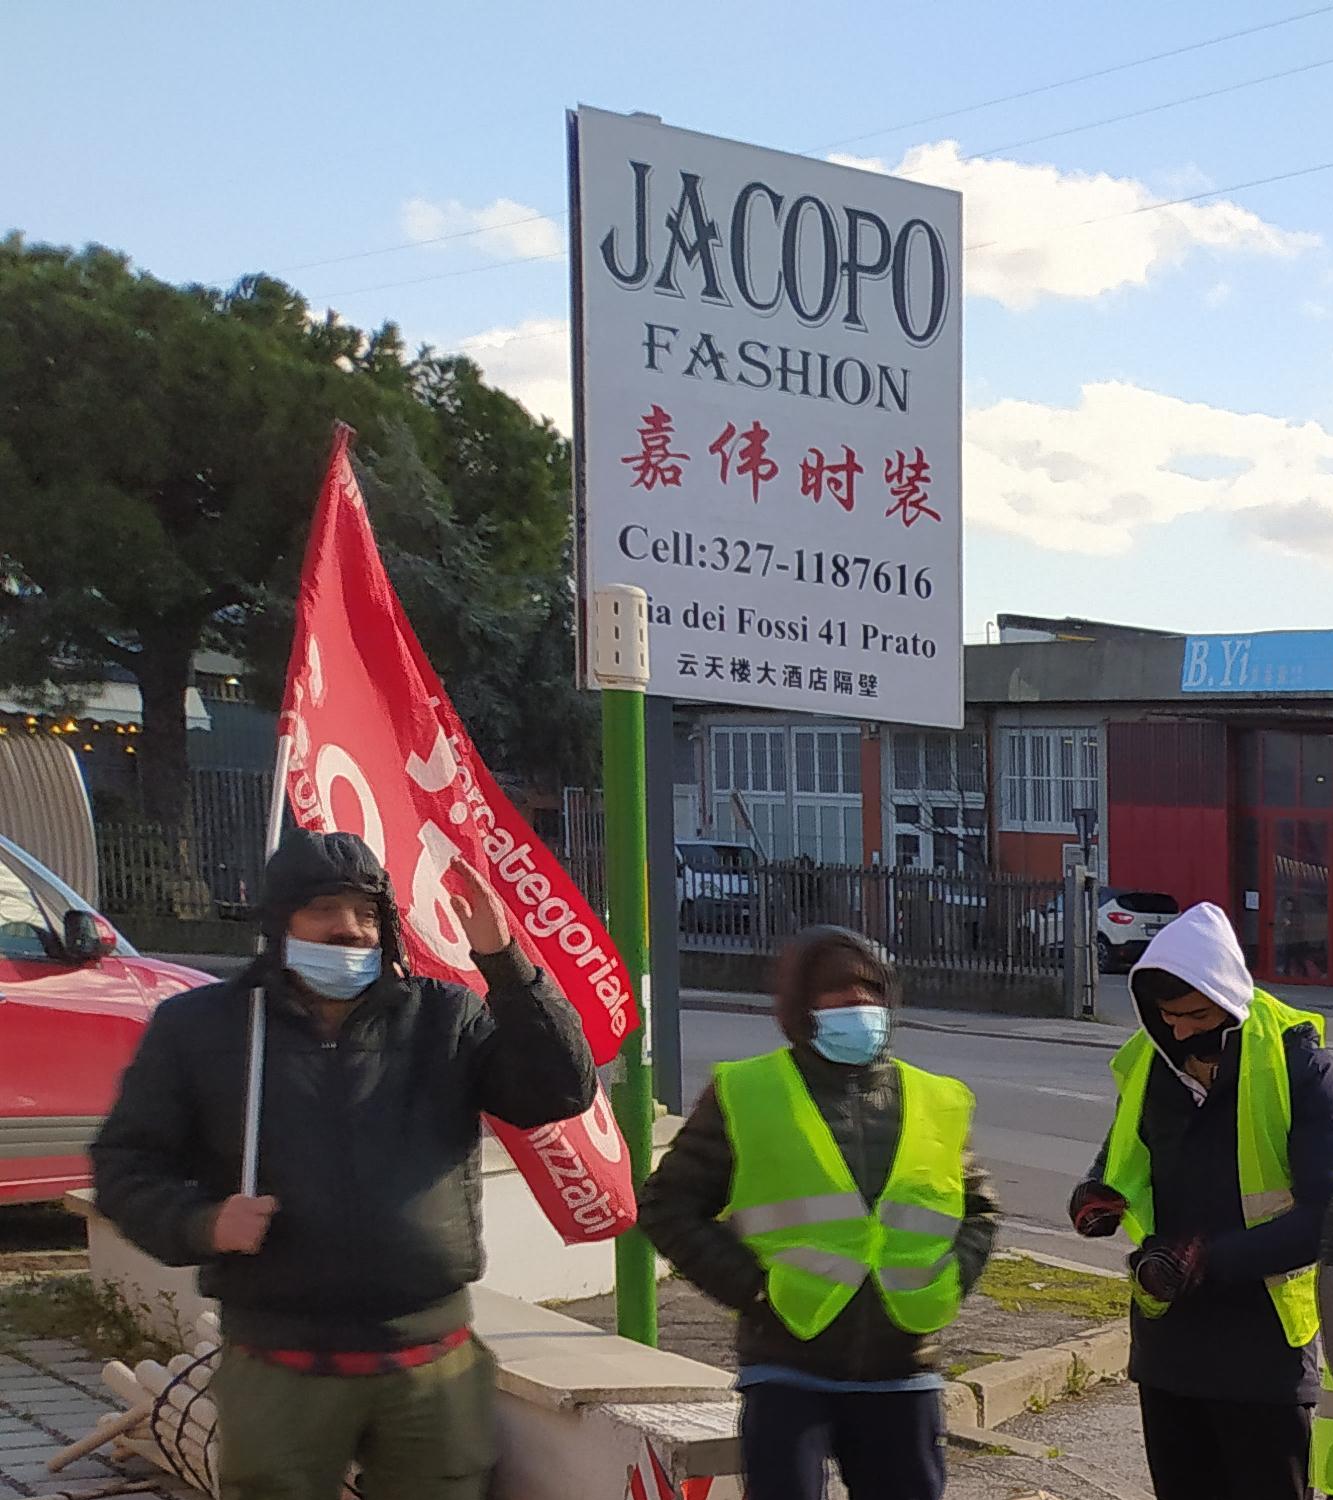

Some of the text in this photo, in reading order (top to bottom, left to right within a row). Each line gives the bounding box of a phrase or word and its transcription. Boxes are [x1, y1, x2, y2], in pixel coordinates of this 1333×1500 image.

[600, 158, 950, 349] JACOPO
[641, 321, 911, 415] FASHION
[620, 403, 943, 528] 嘉伟时装
[618, 523, 934, 600] Cell:327-1187616
[645, 596, 938, 660] ia dei Fossi 41 Prato
[676, 652, 880, 698] 云天楼大酒店隔壁
